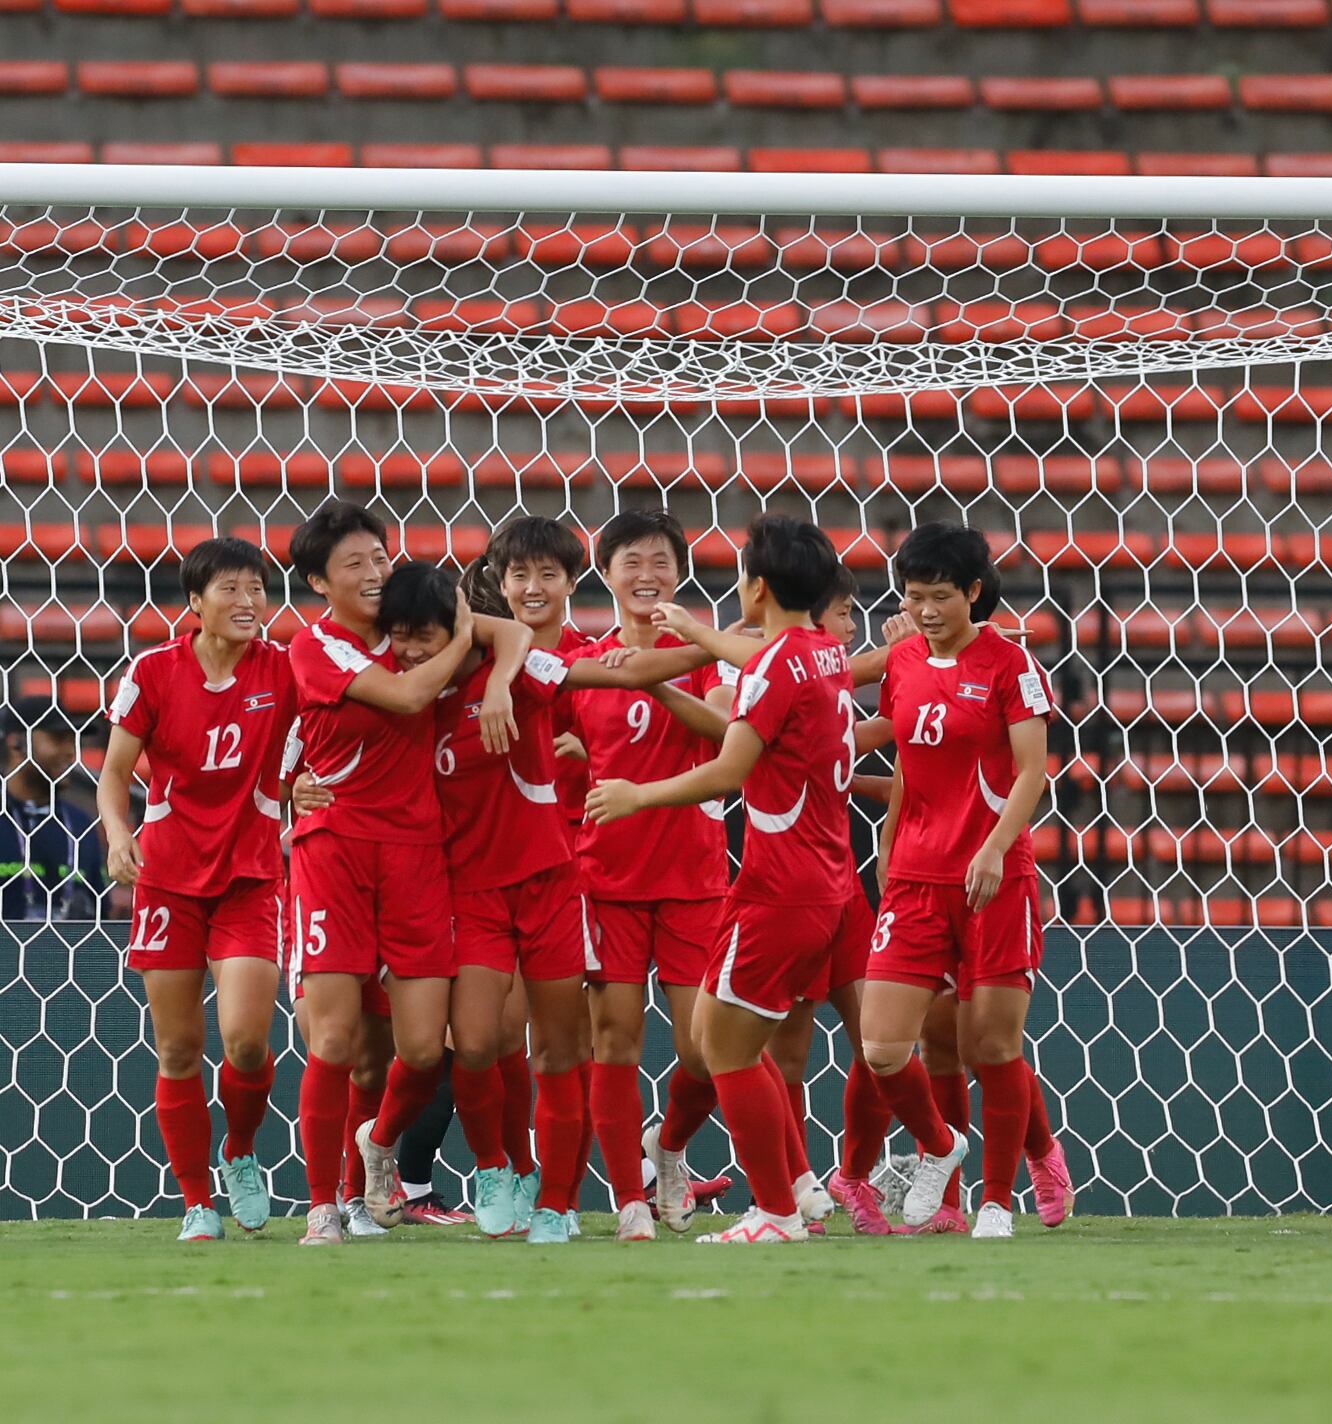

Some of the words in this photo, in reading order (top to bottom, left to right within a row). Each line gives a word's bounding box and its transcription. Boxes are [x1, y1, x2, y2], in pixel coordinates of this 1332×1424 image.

[627, 700, 650, 743] 9
[834, 689, 856, 793] 3
[908, 703, 948, 746] 13
[200, 723, 242, 772] 12
[435, 733, 456, 776] 6
[131, 905, 171, 951] 12
[306, 909, 327, 956] 5
[872, 911, 896, 953] 3
